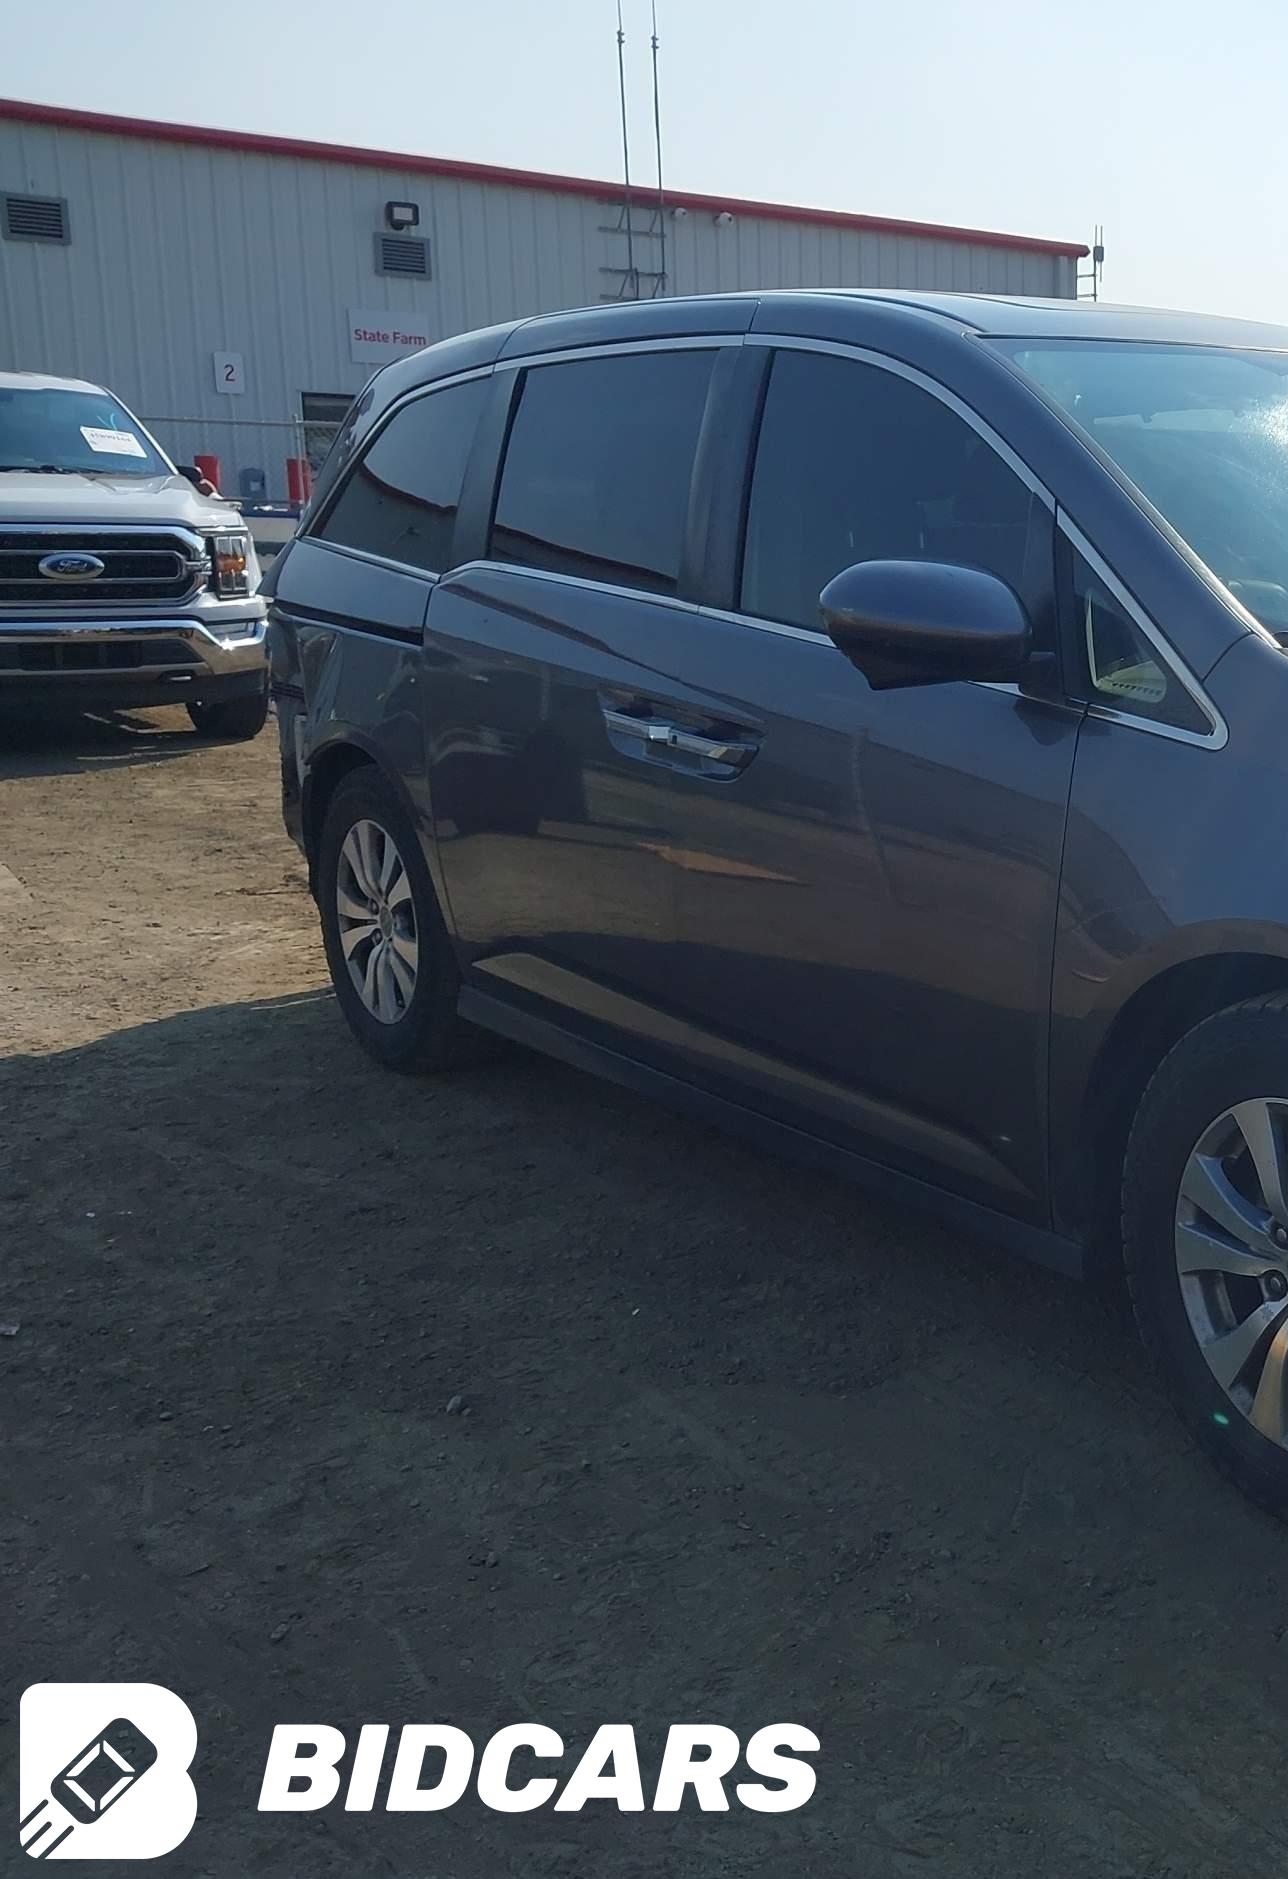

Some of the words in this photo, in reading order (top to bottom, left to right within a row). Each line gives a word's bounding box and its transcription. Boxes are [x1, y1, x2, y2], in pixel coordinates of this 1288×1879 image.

[353, 328, 390, 345] State
[392, 331, 427, 347] Farm
[223, 364, 236, 382] 2
[57, 559, 88, 572] Ford
